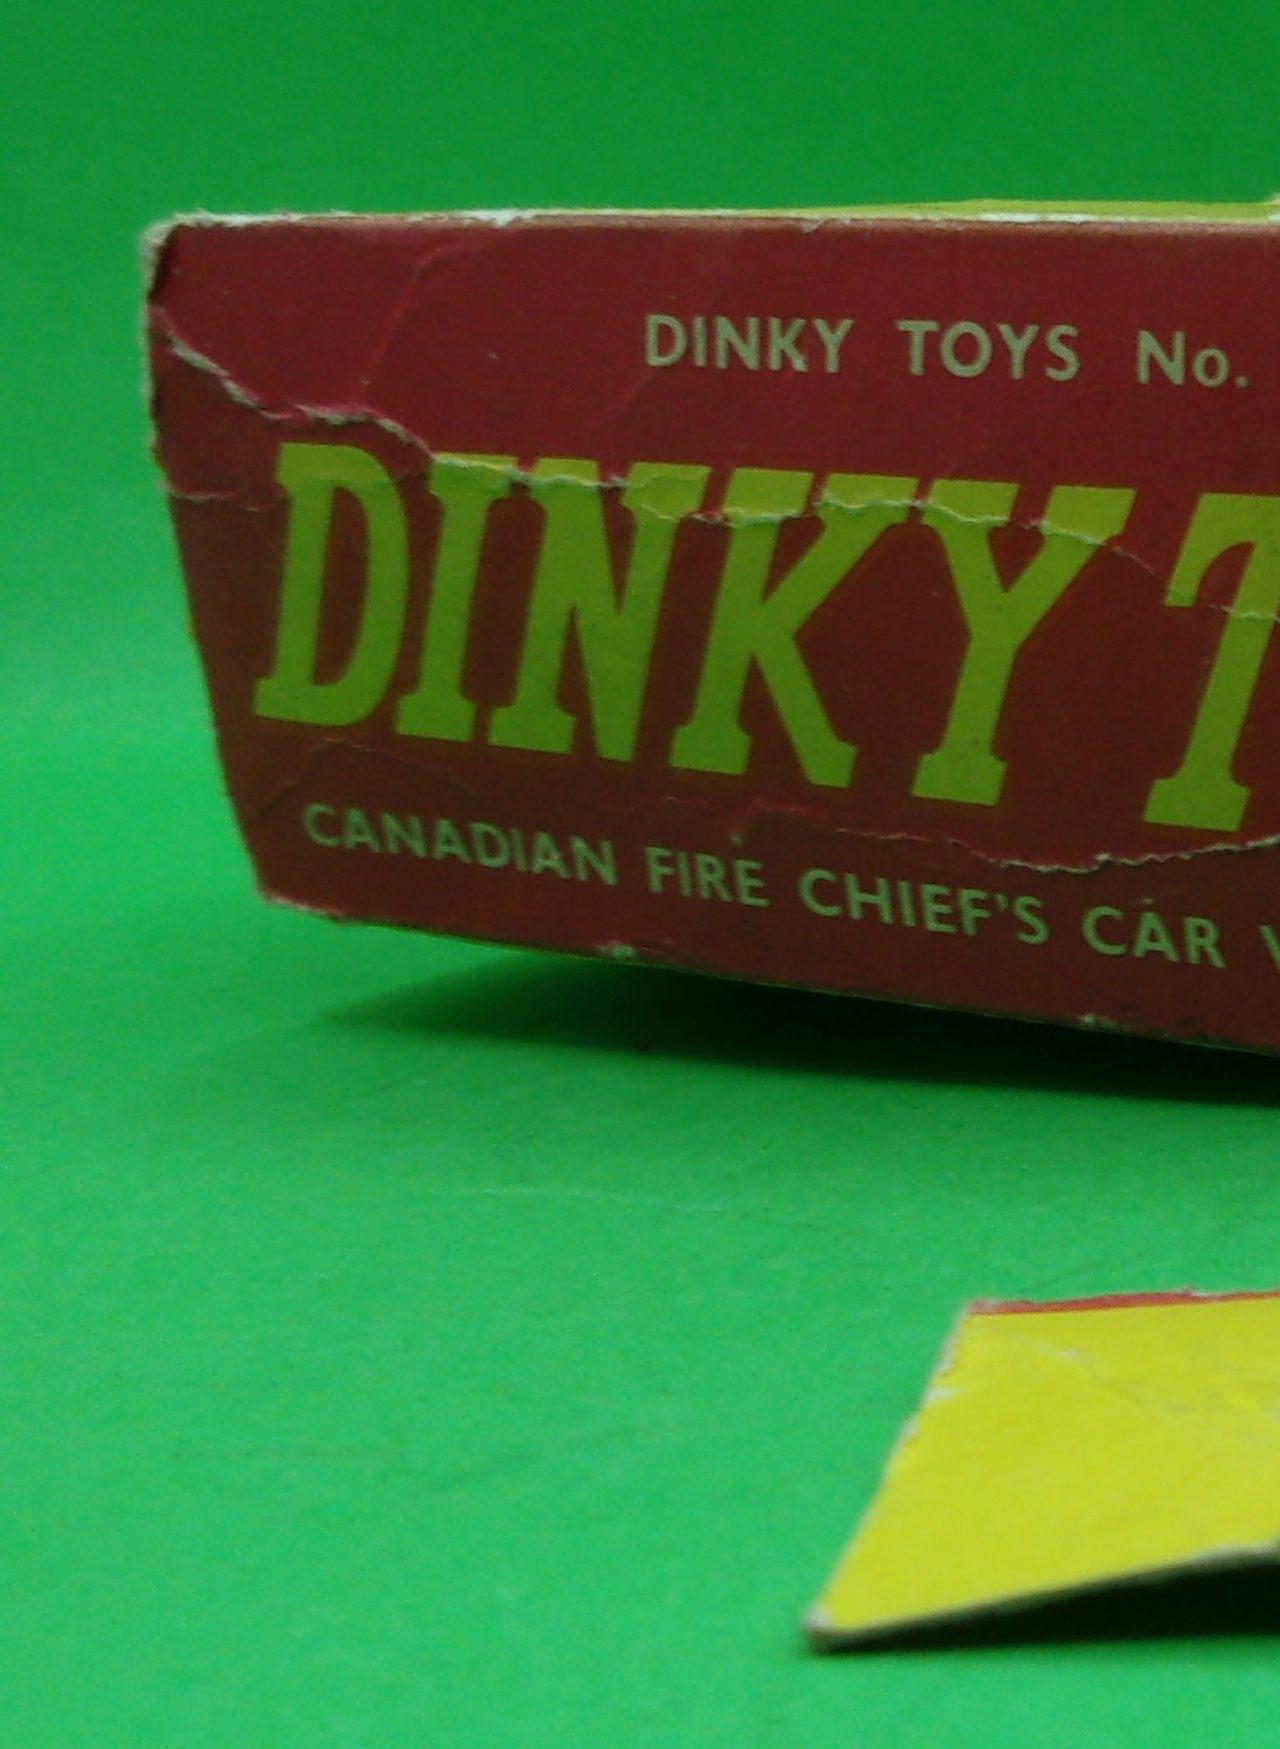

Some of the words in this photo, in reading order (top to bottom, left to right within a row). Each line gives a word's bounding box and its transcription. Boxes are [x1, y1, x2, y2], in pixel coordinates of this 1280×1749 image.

[643, 313, 854, 374] DINKY
[897, 318, 1081, 381] TOYS
[1136, 330, 1249, 388] No.
[253, 441, 1138, 807] DINKY
[303, 801, 619, 886] CANADIAN
[645, 846, 770, 908] FIRE
[800, 868, 1050, 946] CHIEF'S
[1082, 904, 1225, 969] CAR
